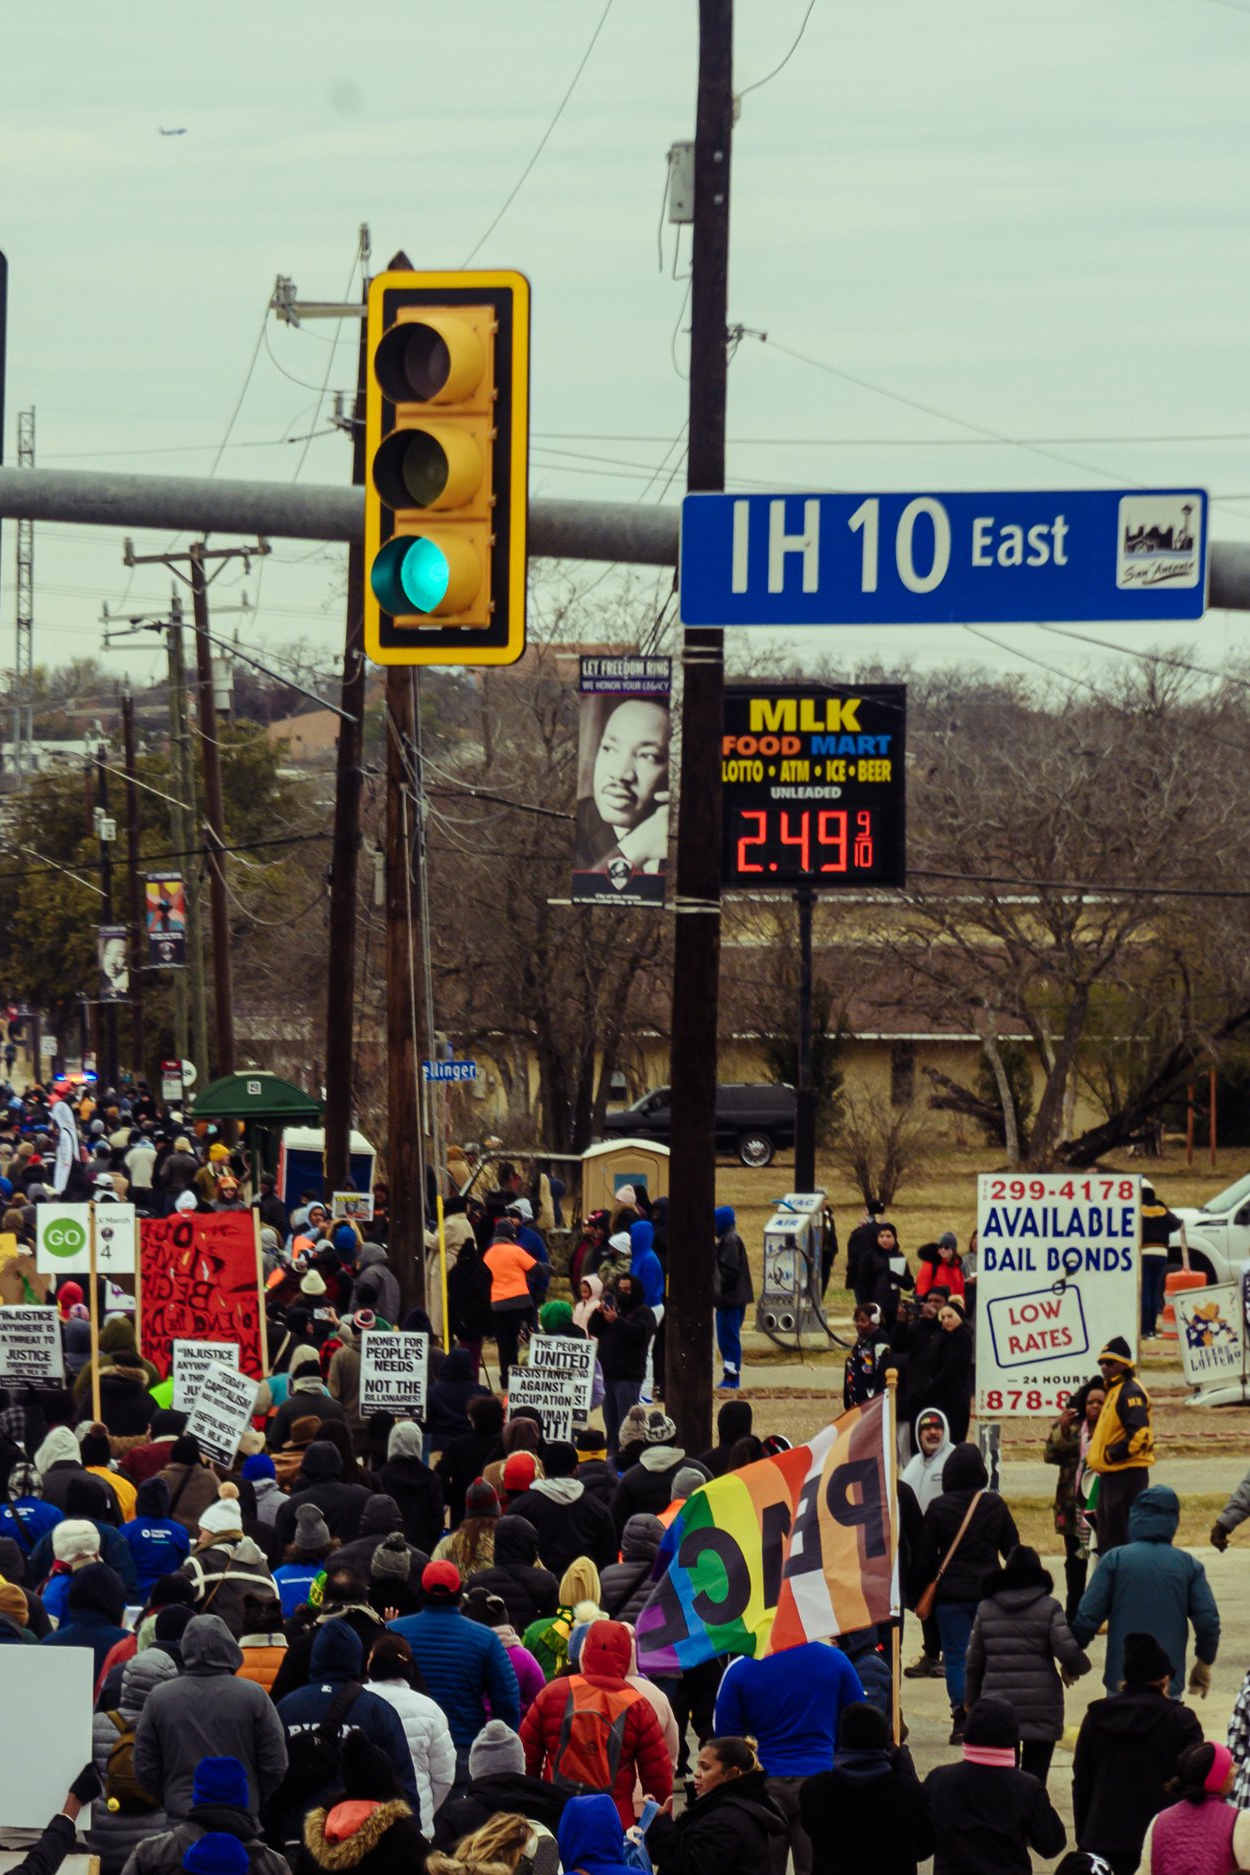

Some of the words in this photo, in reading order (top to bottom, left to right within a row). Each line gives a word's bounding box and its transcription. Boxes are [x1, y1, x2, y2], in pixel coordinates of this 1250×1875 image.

[731, 499, 821, 594] IH
[847, 496, 951, 595] 10
[971, 514, 1070, 567] East
[1121, 564, 1148, 585] San
[1151, 560, 1195, 578] Antonio
[582, 660, 599, 676] LET
[601, 660, 644, 676] FREEDOM
[646, 660, 669, 677] RING
[596, 681, 621, 690] HONOR
[623, 681, 641, 691] YOUR
[642, 681, 669, 692] LEGACY
[749, 698, 862, 732] MLK
[723, 735, 801, 756] FOOD
[811, 735, 892, 756] MART
[722, 760, 763, 782] LOTTO
[780, 760, 810, 782] ATM
[826, 760, 846, 782] ICE
[857, 760, 892, 782] BEER
[770, 786, 842, 800] UNLEADED
[737, 810, 848, 873] 2.49
[422, 1061, 477, 1081] ellinger
[990, 1180, 1134, 1201] 299-4178
[775, 1219, 799, 1227] AIR
[982, 1206, 1136, 1238] AVAILABLE
[48, 1229, 81, 1247] GO
[100, 1244, 112, 1259] 4
[983, 1246, 1037, 1272] BAIL
[1046, 1246, 1133, 1273] BONDS
[1008, 1299, 1062, 1326] LOW
[10, 1336, 42, 1344] THREAT
[44, 1336, 56, 1345] TO
[366, 1336, 402, 1347] MONEY
[404, 1337, 423, 1348] FOR
[535, 1339, 553, 1350] THE
[555, 1341, 592, 1354] PEOPLE
[1008, 1326, 1073, 1355] RATES
[6, 1349, 52, 1362] JUSTICE
[365, 1347, 424, 1360] PEOPLE'S
[534, 1350, 590, 1370] UNITED
[176, 1361, 210, 1371] ANYWH
[374, 1360, 414, 1373] NEEDS
[511, 1367, 574, 1380] RESISTANCE
[364, 1380, 391, 1393] NOT
[395, 1380, 422, 1395] THE
[519, 1380, 565, 1393] AGAINST
[1023, 1376, 1038, 1385] 24
[1042, 1375, 1091, 1385] HOURS
[204, 1378, 253, 1410] CAPITALISM
[364, 1393, 421, 1403] BILLIONAIRES!
[510, 1392, 572, 1407] OCCUPATION
[986, 1389, 1071, 1411] 878-8
[541, 1409, 569, 1422] UMAN
